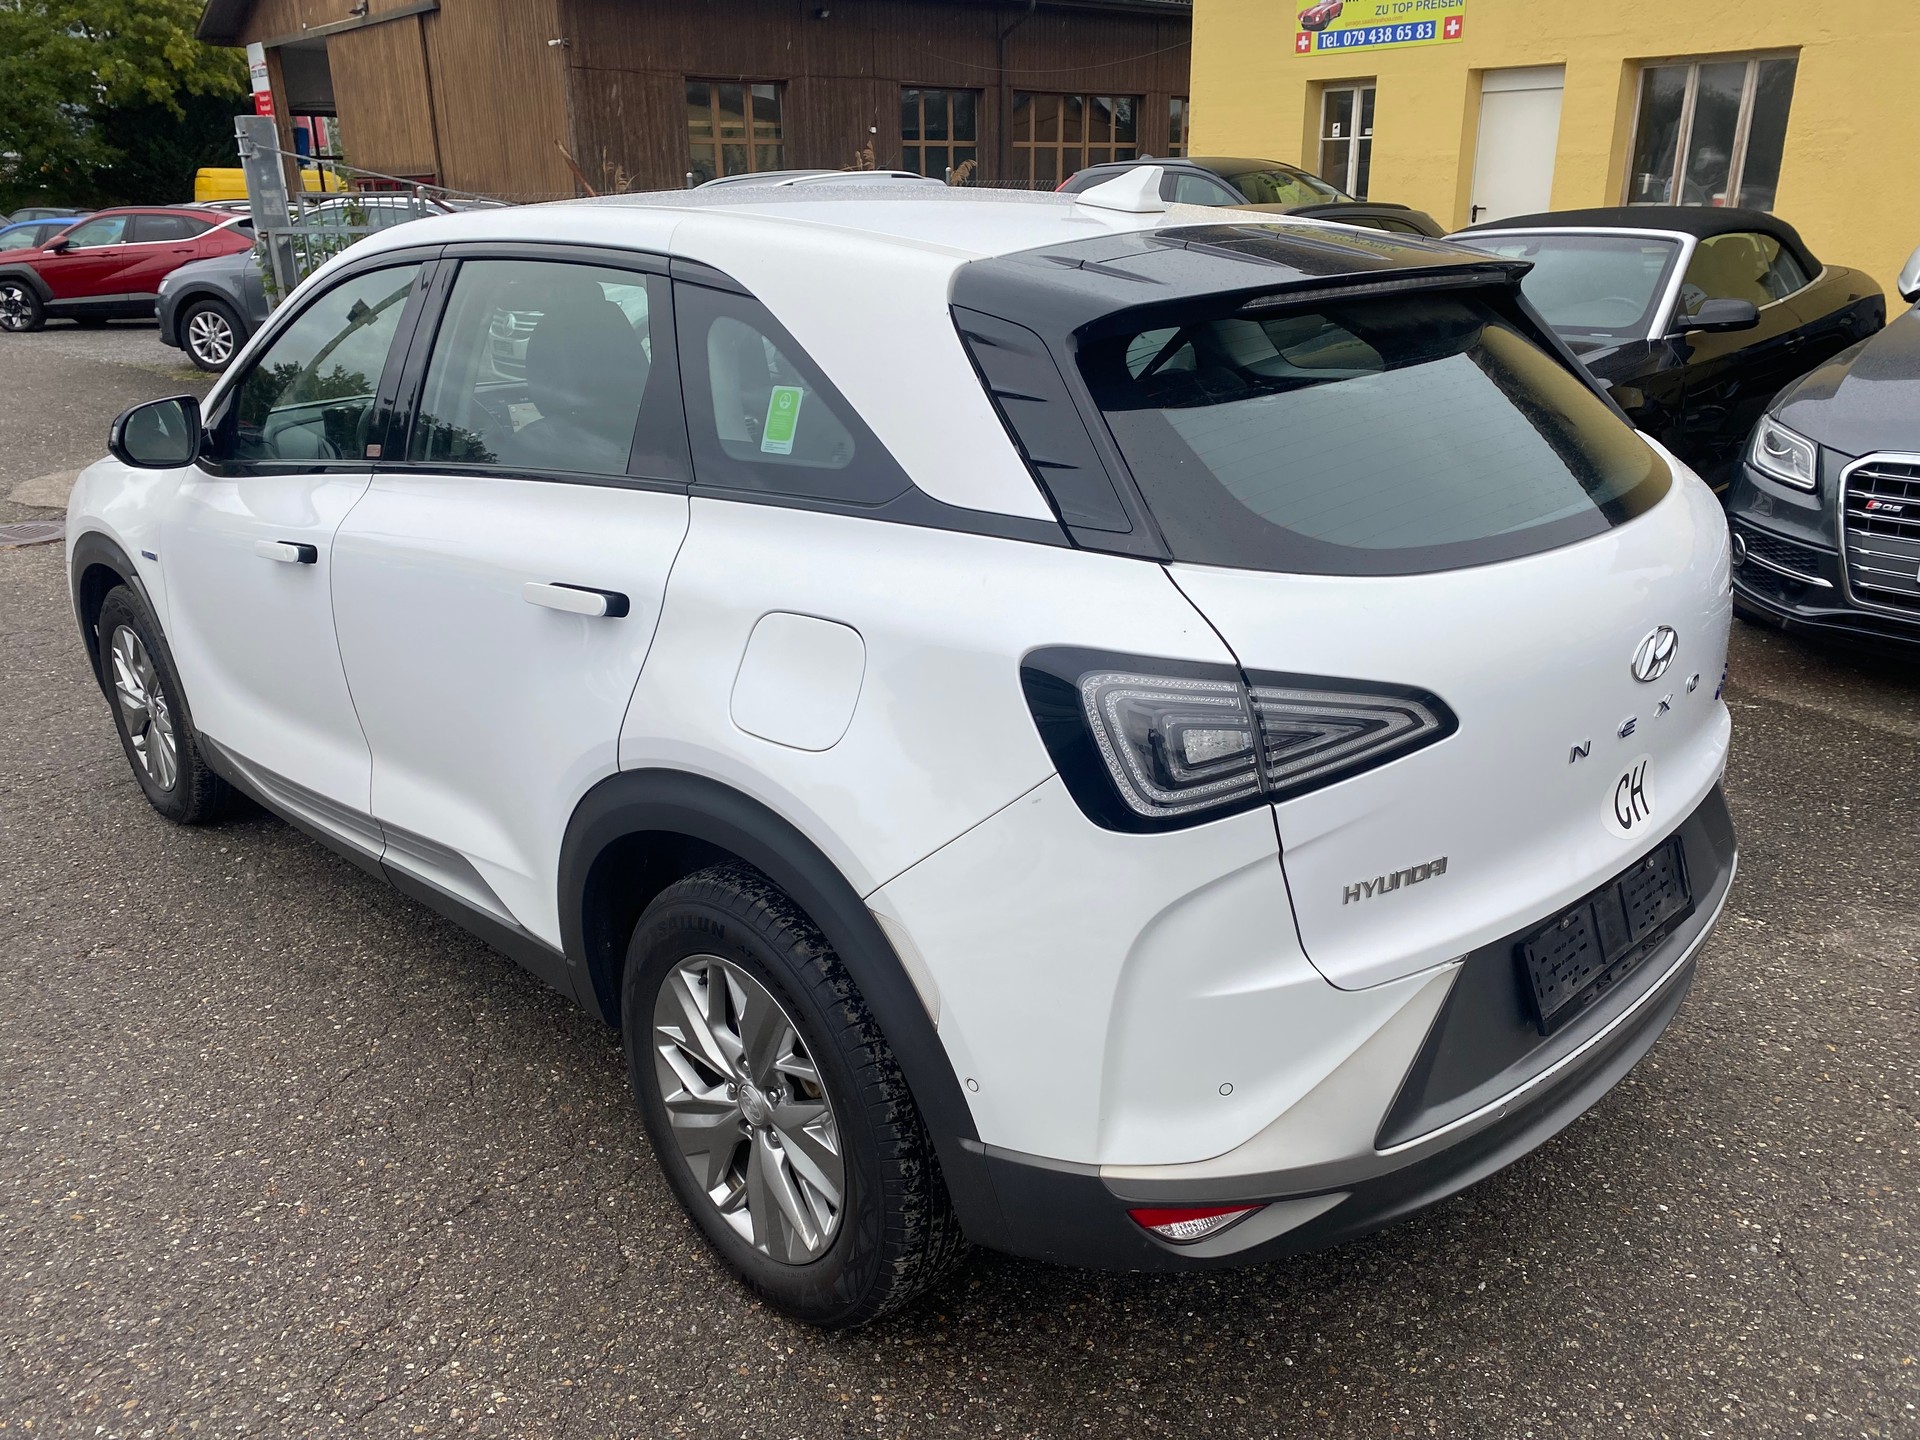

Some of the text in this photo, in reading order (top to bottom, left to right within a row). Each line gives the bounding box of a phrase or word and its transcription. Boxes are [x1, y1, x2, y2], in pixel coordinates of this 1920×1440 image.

[1375, 0, 1463, 16] ZU TOP PREISEN
[1321, 23, 1433, 48] Tel. 079 438 65 83
[1569, 673, 1700, 764] NEXO
[1614, 760, 1650, 829] CH
[1342, 855, 1448, 905] HYUNDAI
